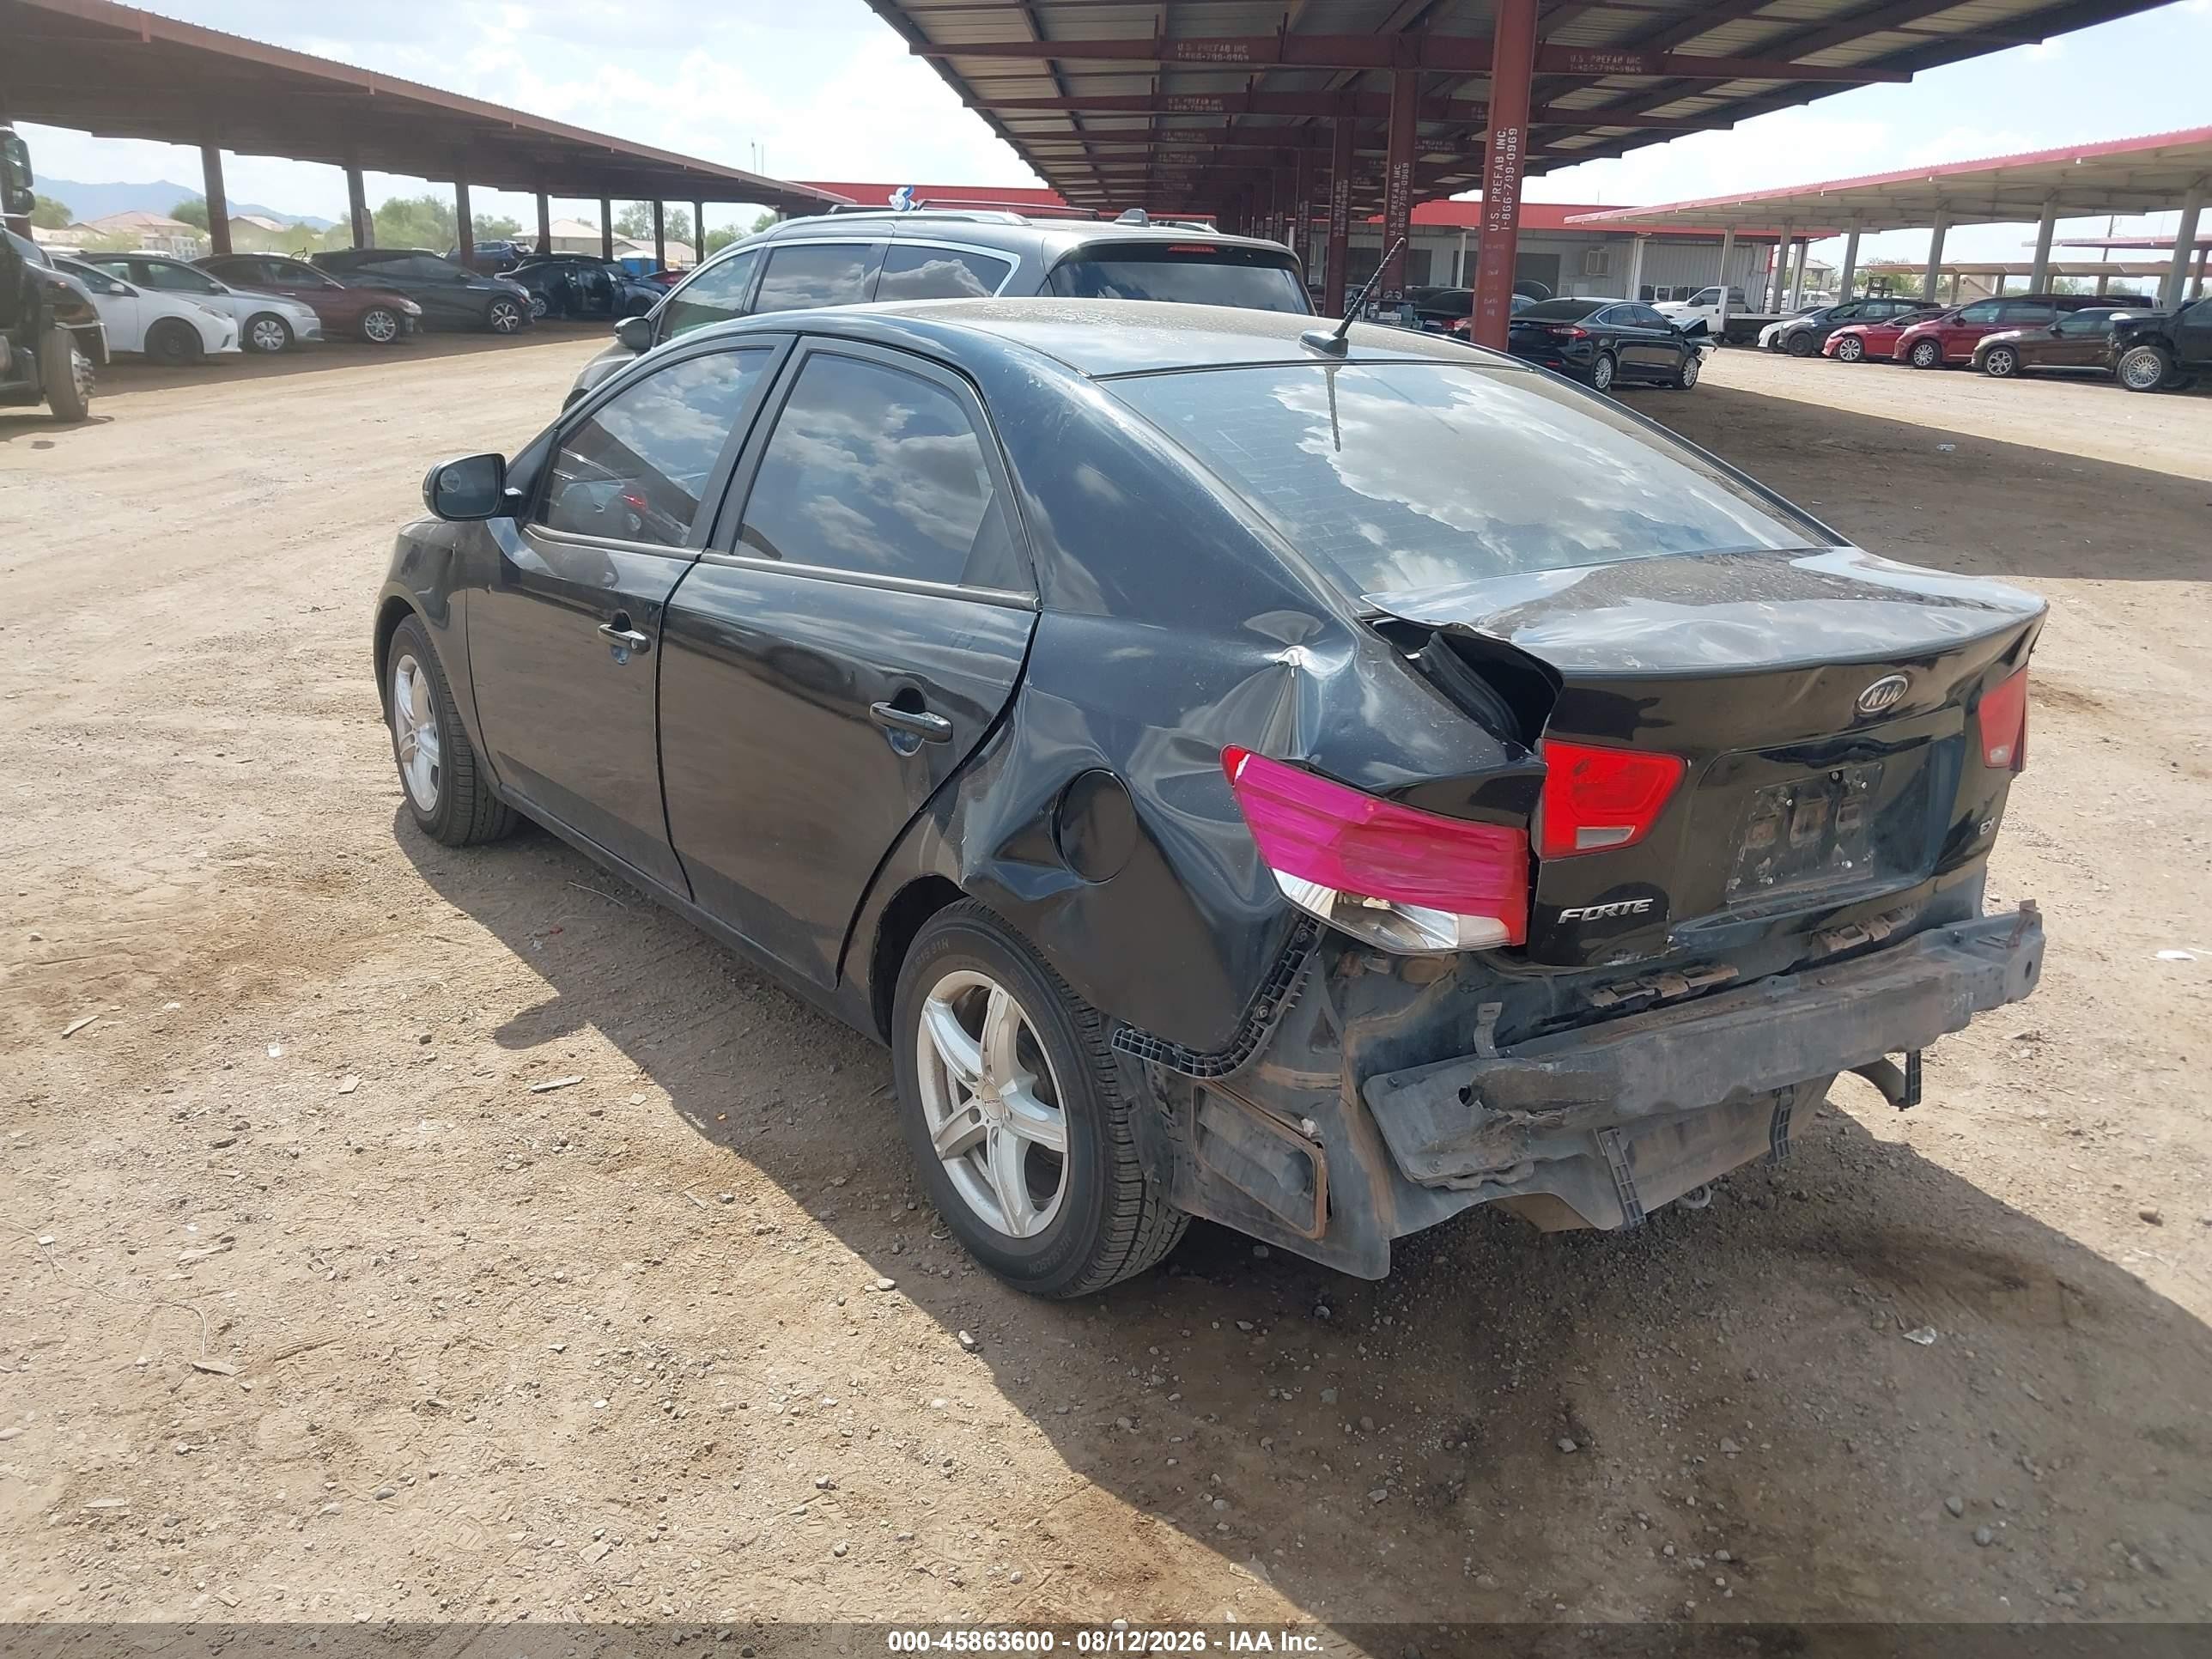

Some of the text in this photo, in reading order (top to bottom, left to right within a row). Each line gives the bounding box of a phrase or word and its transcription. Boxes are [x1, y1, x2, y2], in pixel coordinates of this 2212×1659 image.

[1496, 127, 1507, 149] INC.
[1492, 155, 1504, 203] PREFAB
[1500, 128, 1518, 230] 1-866-799-0969
[1390, 182, 1400, 216] PREFAB
[1489, 209, 1500, 232] U.S.
[1865, 684, 1900, 707] KIA
[1558, 898, 1655, 924] FORTE
